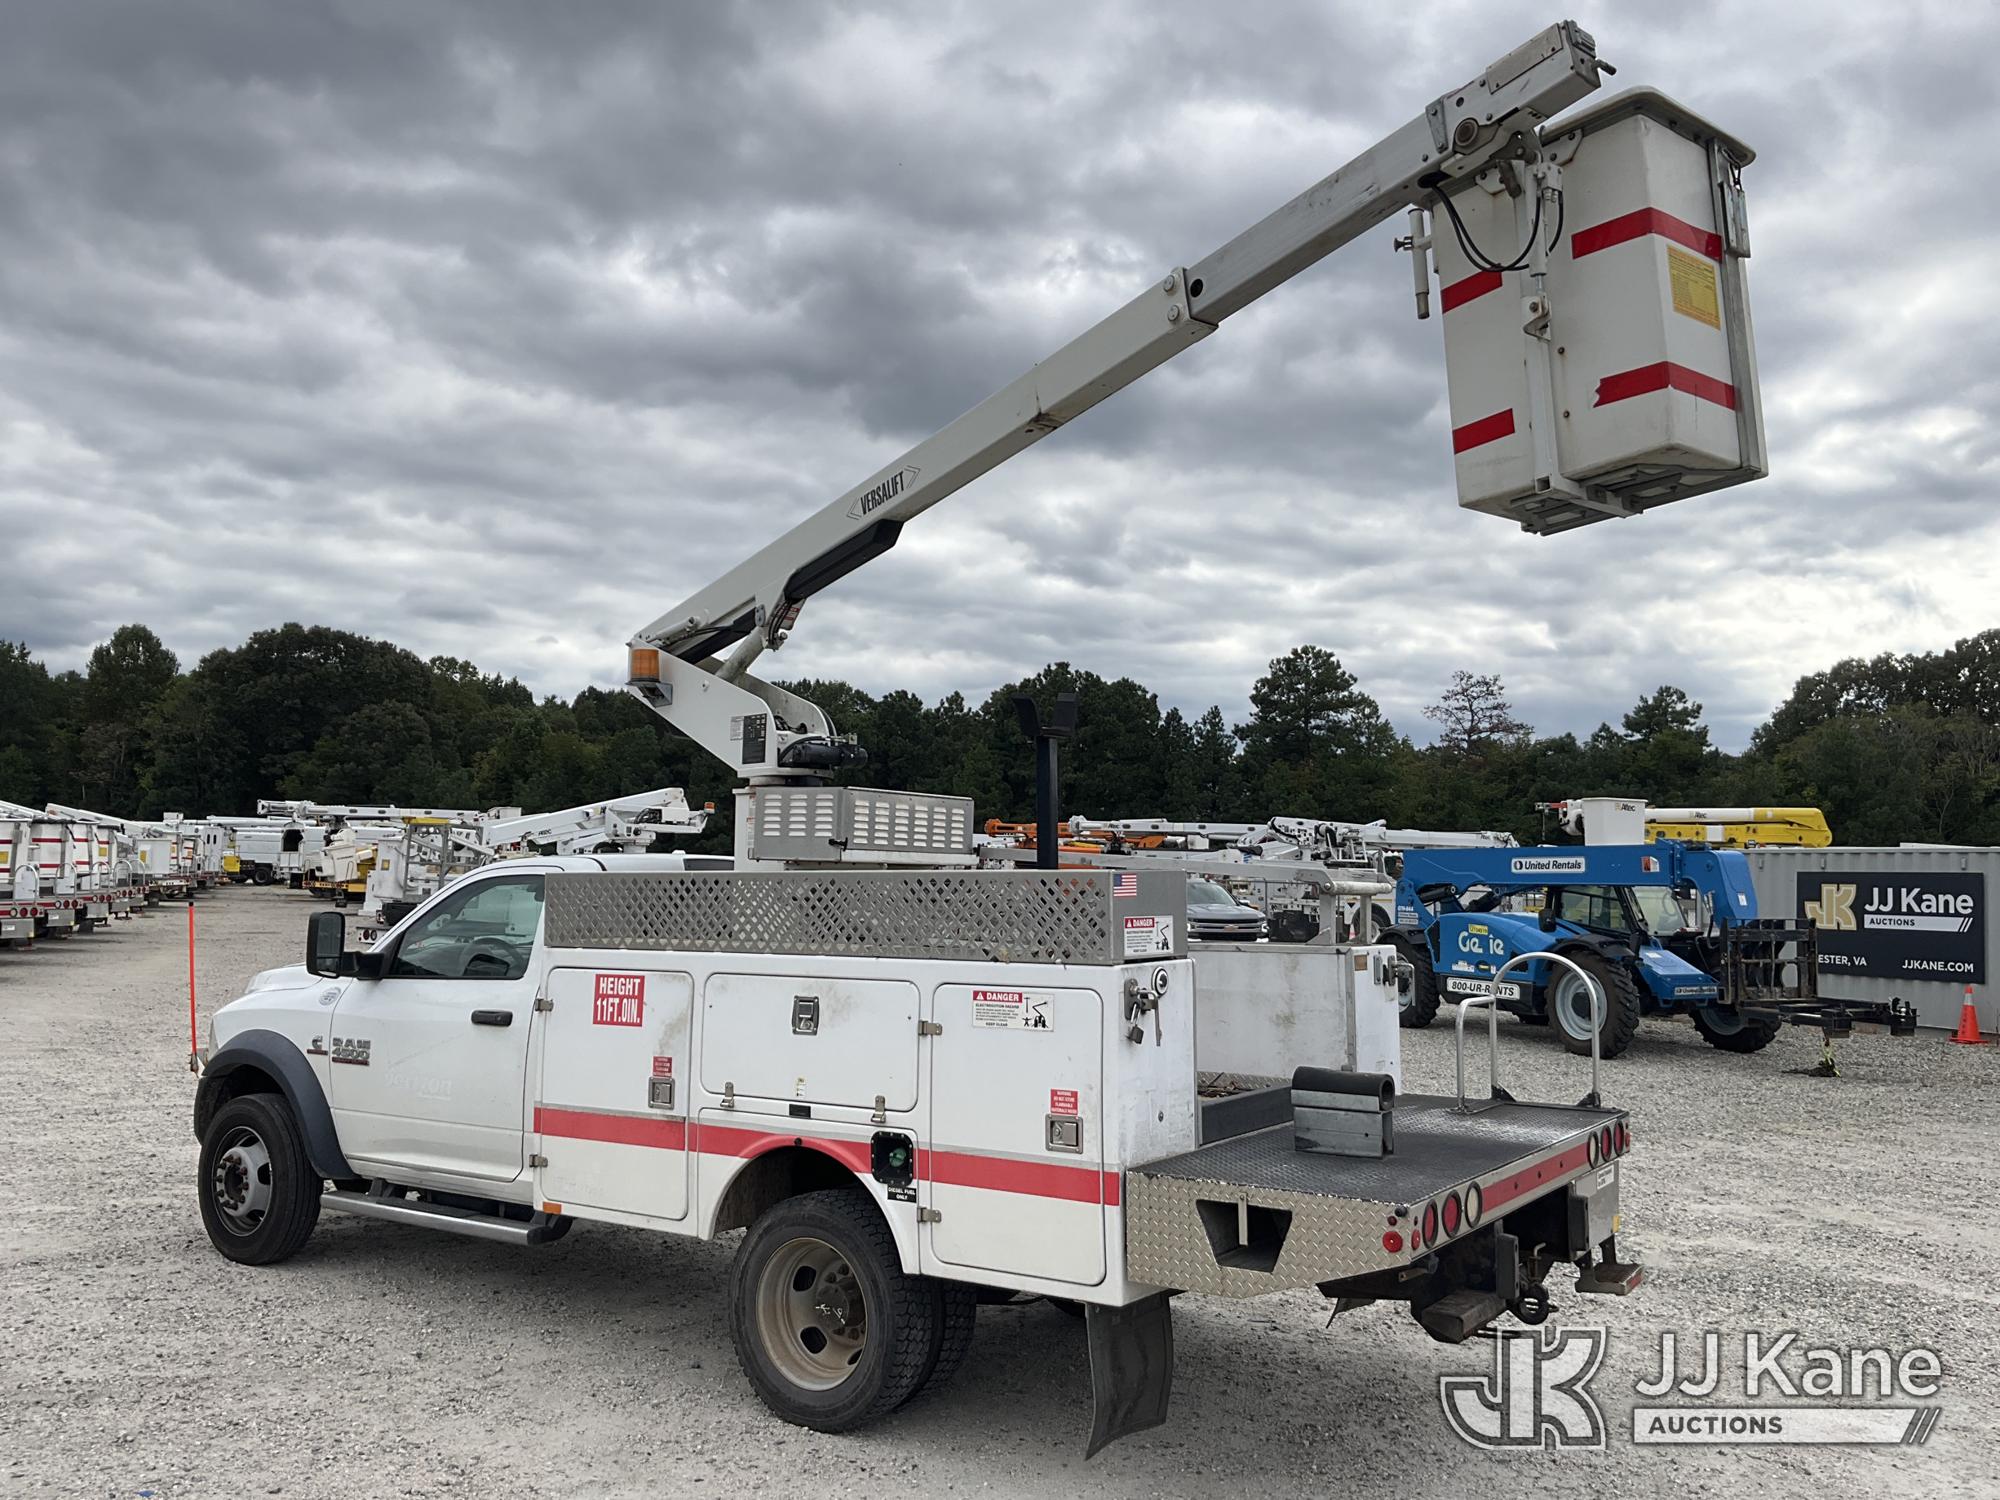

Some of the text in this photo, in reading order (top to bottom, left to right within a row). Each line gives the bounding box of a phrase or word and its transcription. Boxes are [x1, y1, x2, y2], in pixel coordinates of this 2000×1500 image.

[860, 470, 905, 515] VERSALIFT
[1524, 859, 1582, 870] United Rentals
[1864, 887, 1974, 914] JJ Kane
[1132, 918, 1153, 927] DANGER
[1869, 917, 1916, 927] AUCTIONS
[1853, 956, 1868, 967] VA
[1902, 959, 1974, 973] JJKANE.COM
[599, 977, 641, 996] HEIGHT
[1451, 981, 1514, 996] 800-UR-RNTS
[986, 992, 1019, 1002] DANGER
[333, 1037, 371, 1049] RAM
